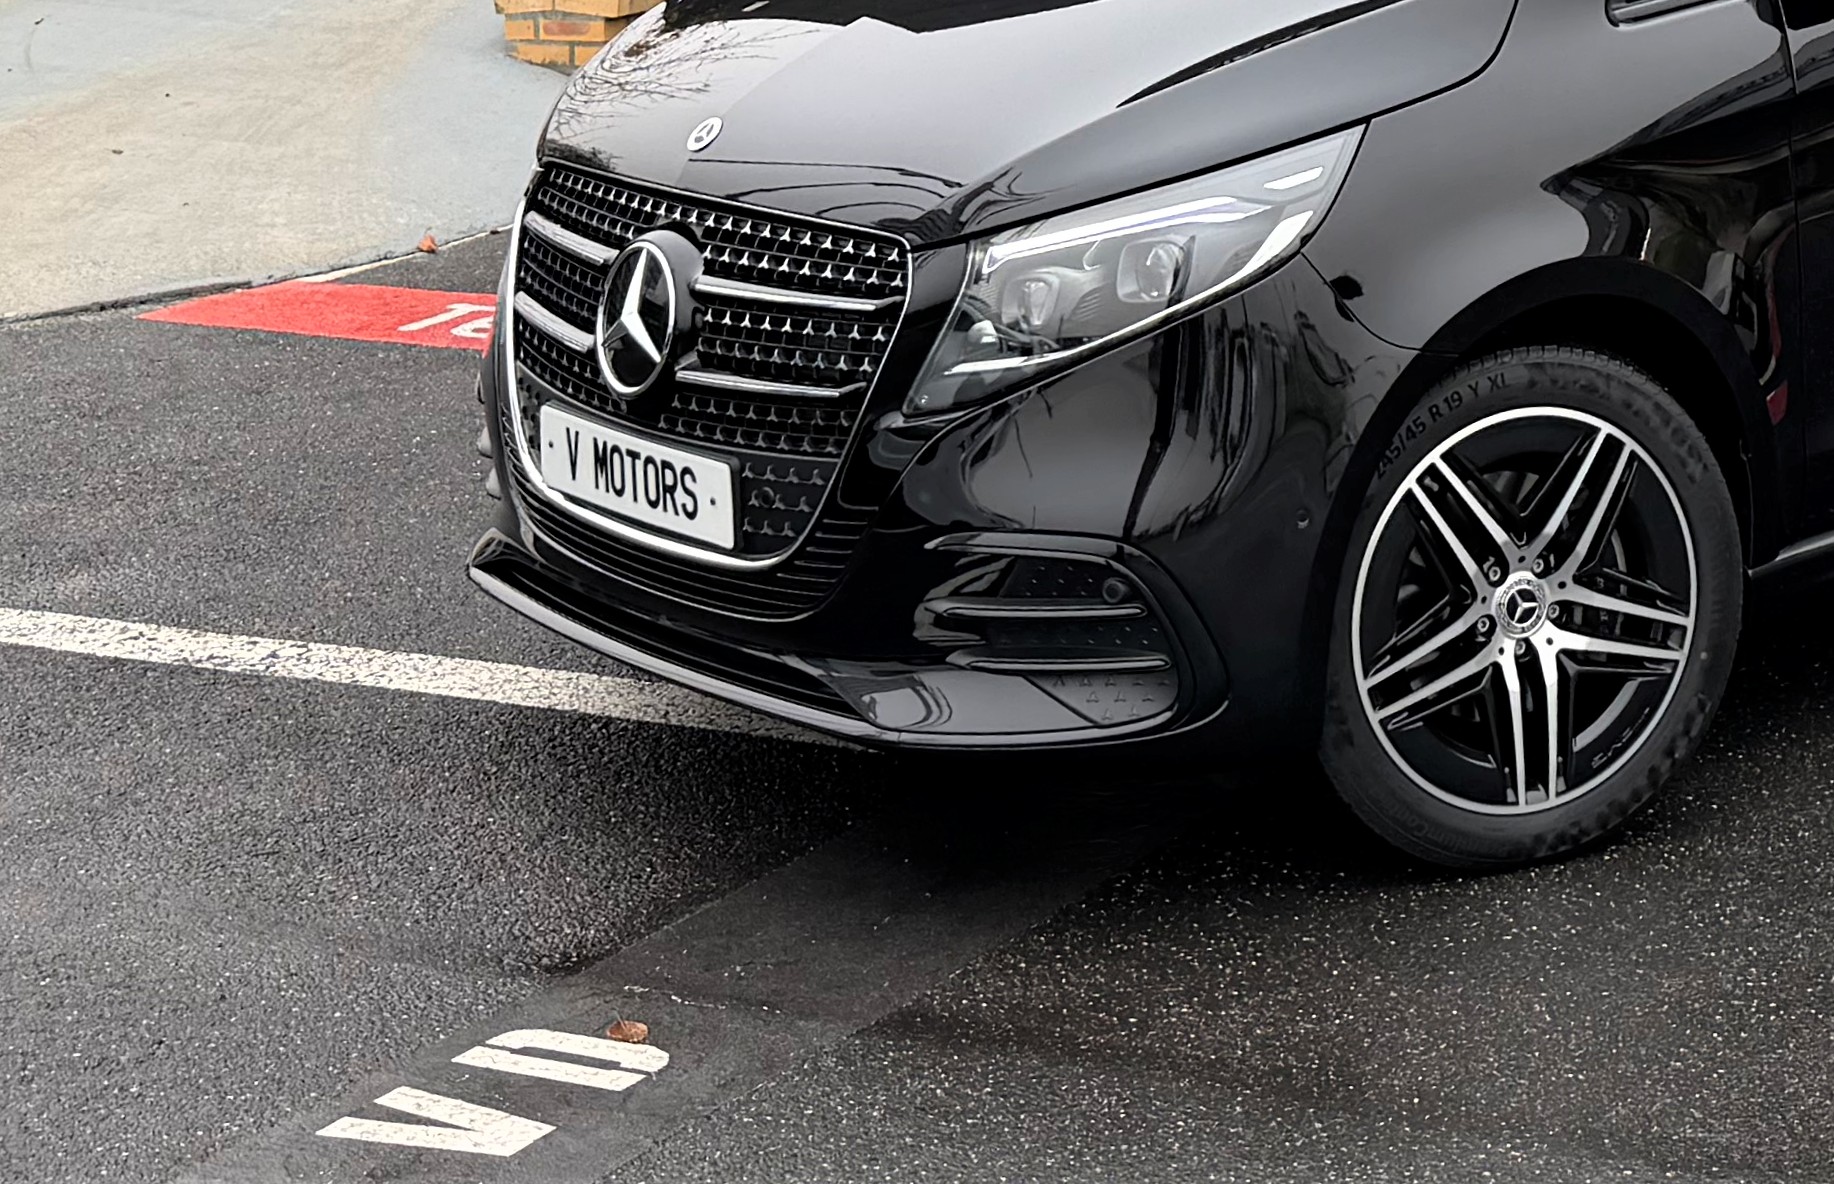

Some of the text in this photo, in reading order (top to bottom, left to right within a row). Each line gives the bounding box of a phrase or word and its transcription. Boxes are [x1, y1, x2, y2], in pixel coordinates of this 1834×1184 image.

[396, 302, 497, 339] Te
[1487, 372, 1511, 394] XL
[563, 426, 700, 522] V MOTORS
